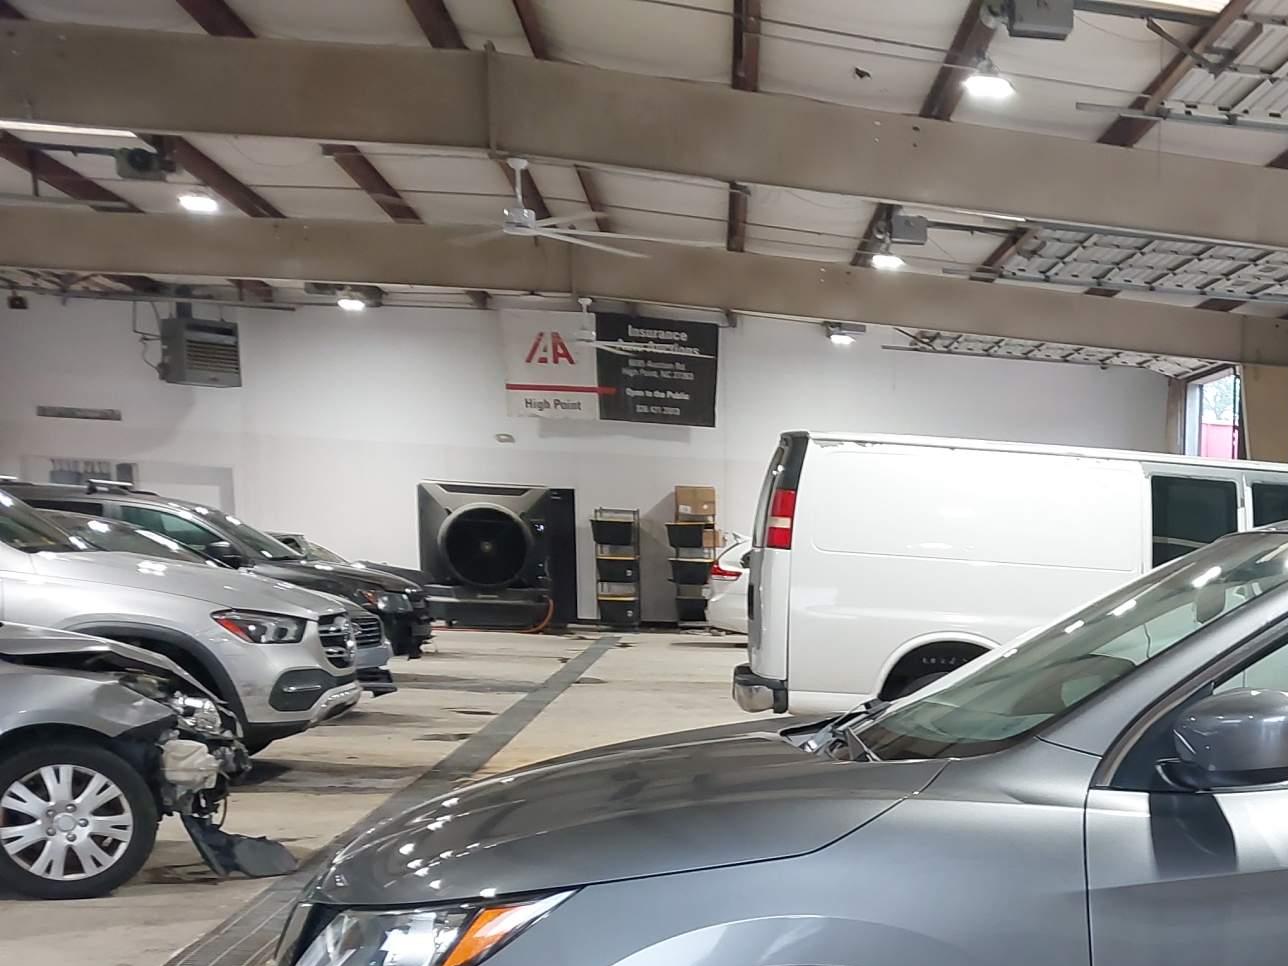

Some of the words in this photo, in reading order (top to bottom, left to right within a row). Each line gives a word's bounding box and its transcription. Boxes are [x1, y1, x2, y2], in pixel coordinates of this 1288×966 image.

[628, 324, 688, 342] Insurance
[524, 398, 551, 411] High
[553, 398, 582, 411] Point
